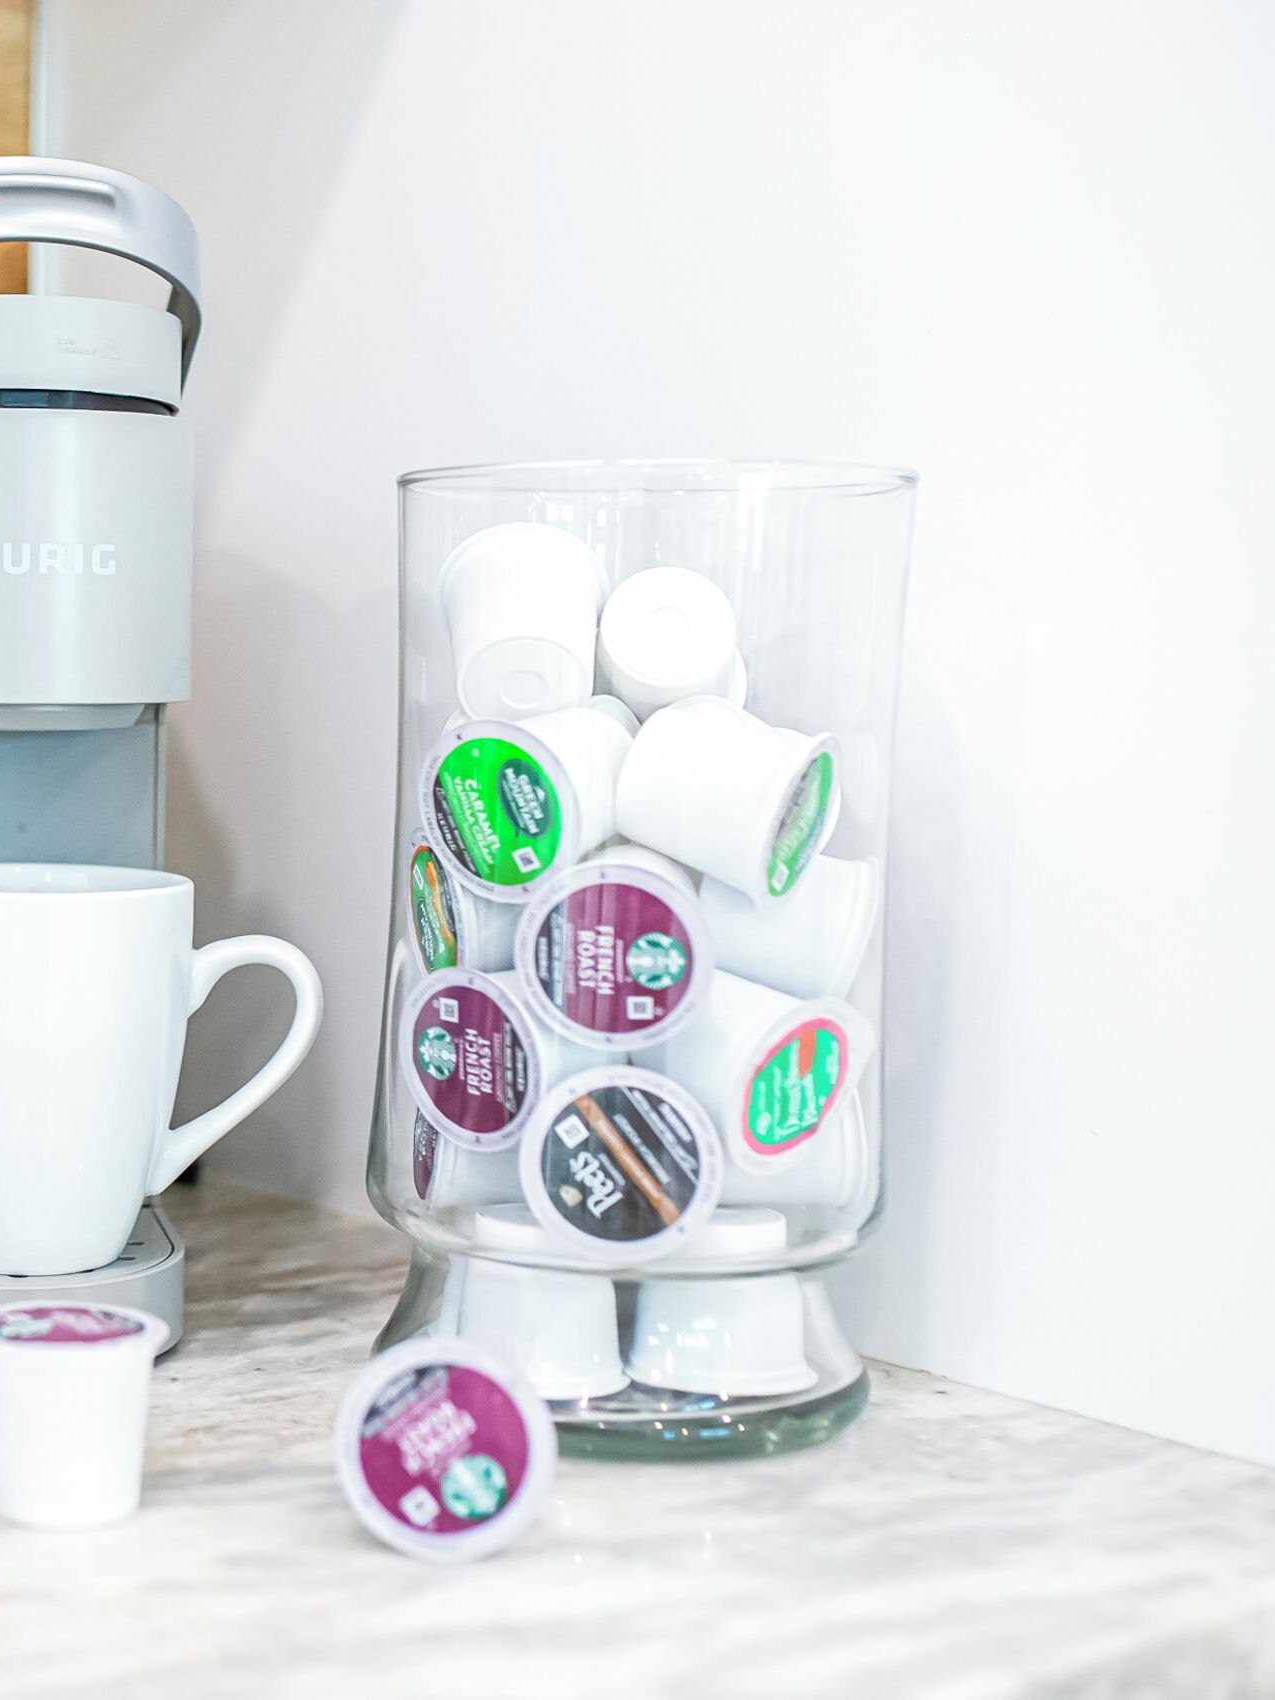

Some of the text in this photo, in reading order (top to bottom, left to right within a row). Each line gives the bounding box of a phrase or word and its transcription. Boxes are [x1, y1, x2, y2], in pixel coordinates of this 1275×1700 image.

[452, 775, 477, 823] VANILLA
[463, 777, 502, 852] CARAMEL
[503, 766, 539, 834] MOUNTAIN
[516, 773, 544, 820] GREEN
[576, 930, 596, 988] ROAST
[594, 925, 614, 994] FRENCH
[465, 1028, 480, 1095] FRENCH
[477, 1036, 492, 1093] ROAST
